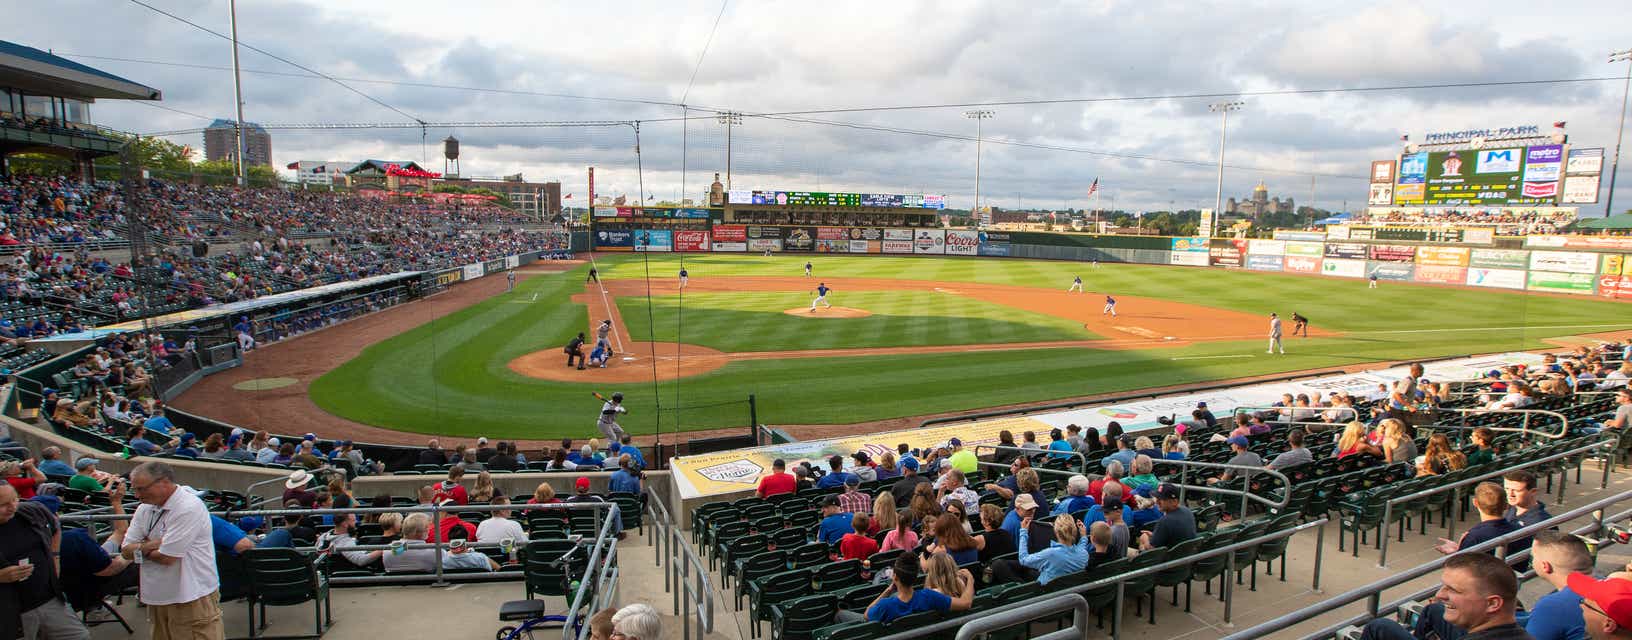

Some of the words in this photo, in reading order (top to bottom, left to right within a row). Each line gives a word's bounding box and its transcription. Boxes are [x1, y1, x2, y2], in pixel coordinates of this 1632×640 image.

[1426, 129, 1494, 141] PRINCIPAL
[1498, 125, 1539, 136] PARK
[1530, 148, 1560, 157] metro
[946, 233, 979, 246] Coors
